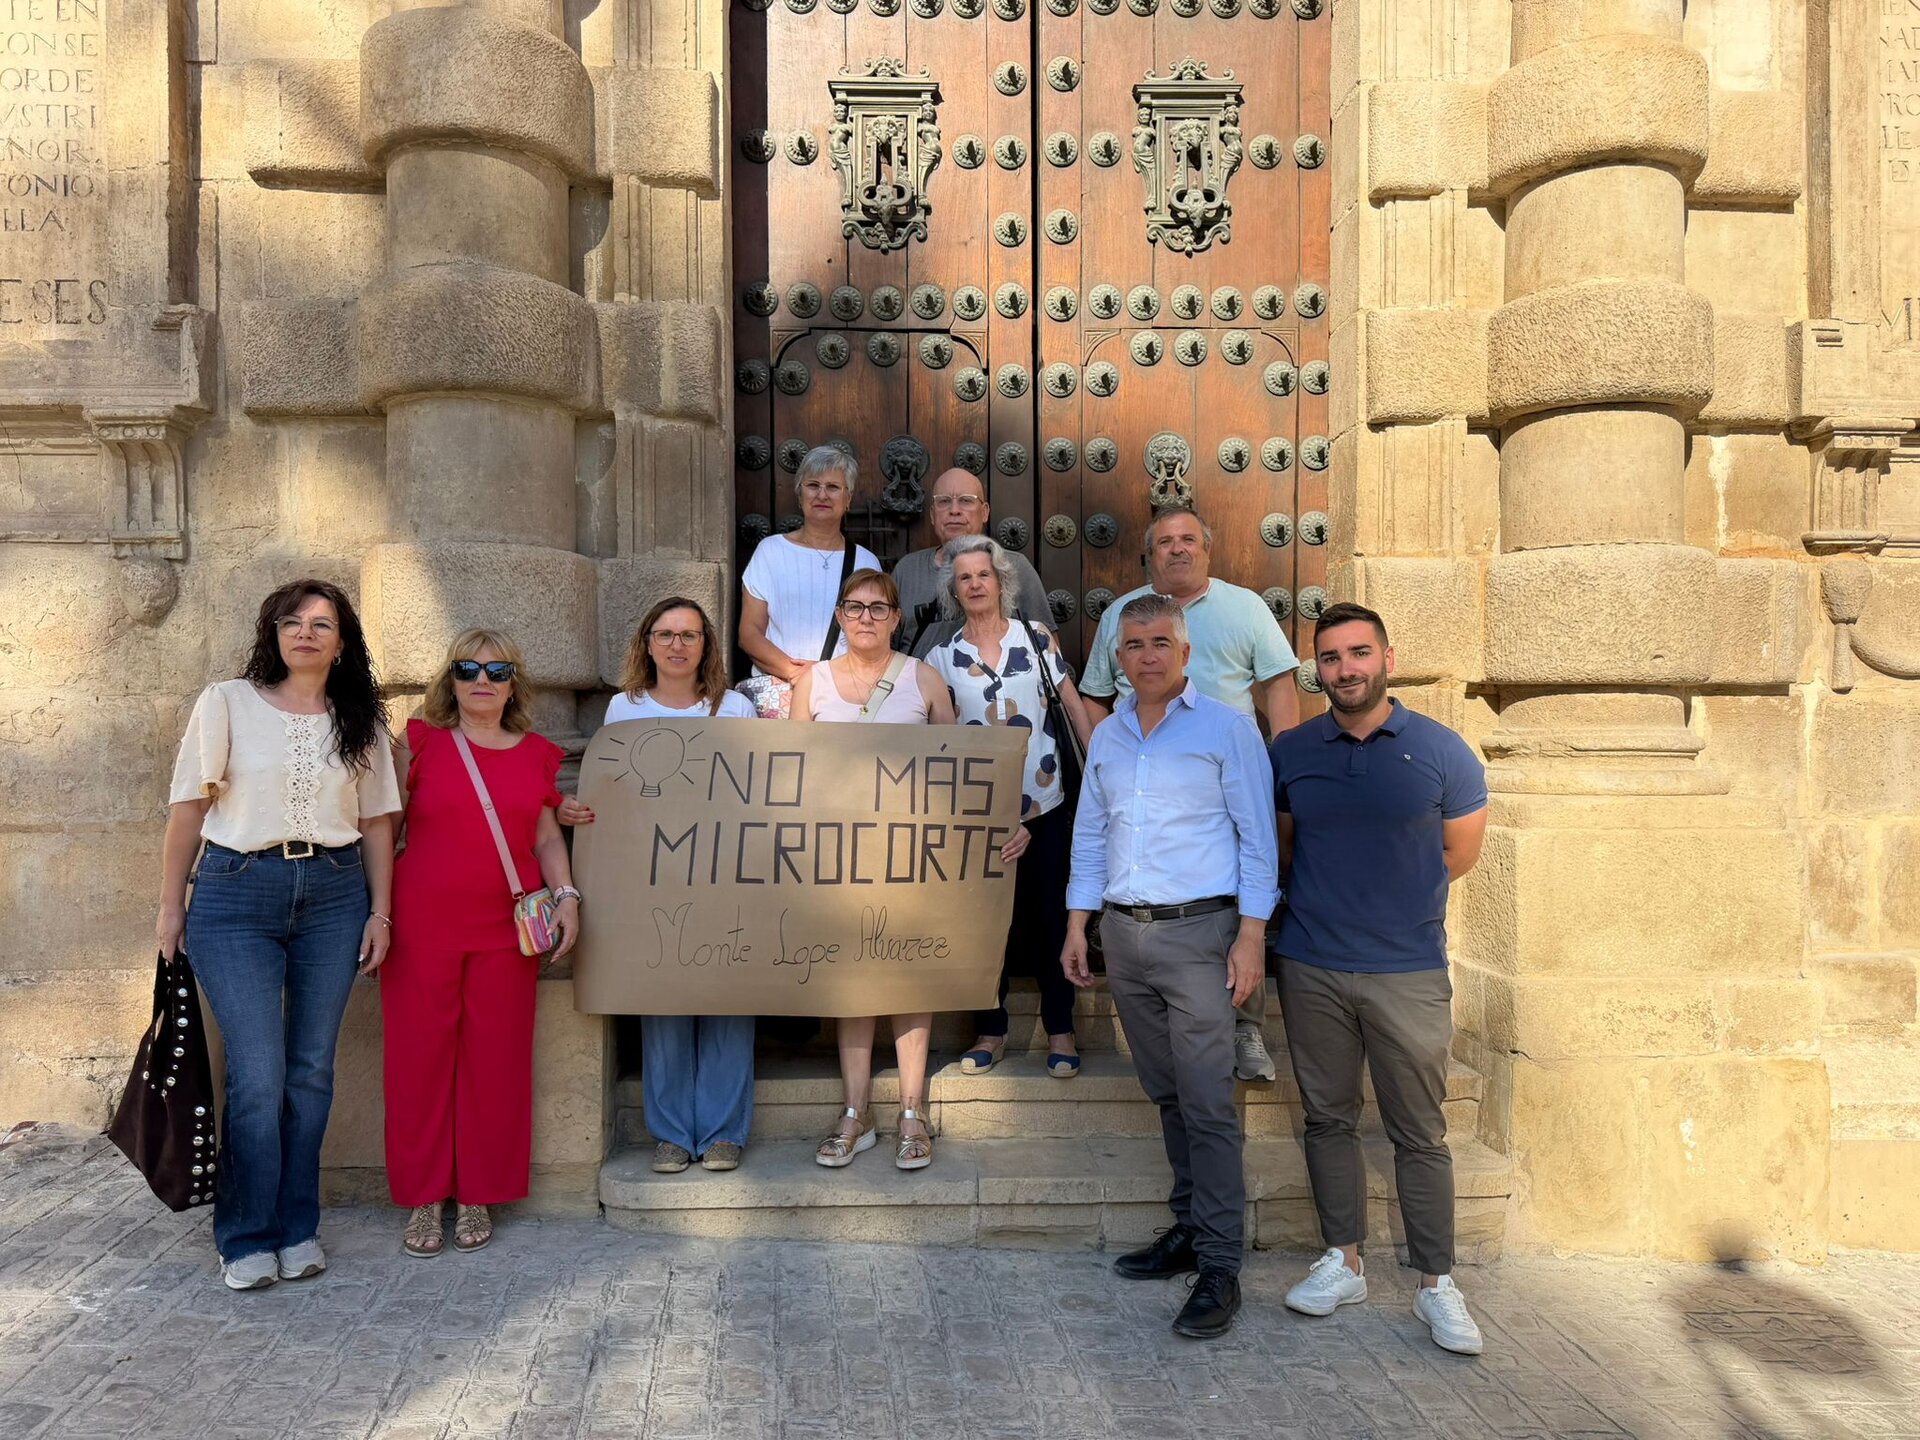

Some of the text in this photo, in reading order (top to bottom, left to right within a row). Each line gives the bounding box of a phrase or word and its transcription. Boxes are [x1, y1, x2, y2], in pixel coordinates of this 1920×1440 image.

[0, 32, 98, 56] ONSE
[0, 68, 94, 93] ORDE
[0, 174, 94, 197] ONIO
[0, 279, 106, 325] ESES
[707, 743, 995, 816] NO MÁS
[650, 821, 1010, 886] MICROCORTE
[646, 902, 952, 985] Monte Lope Alvarez
